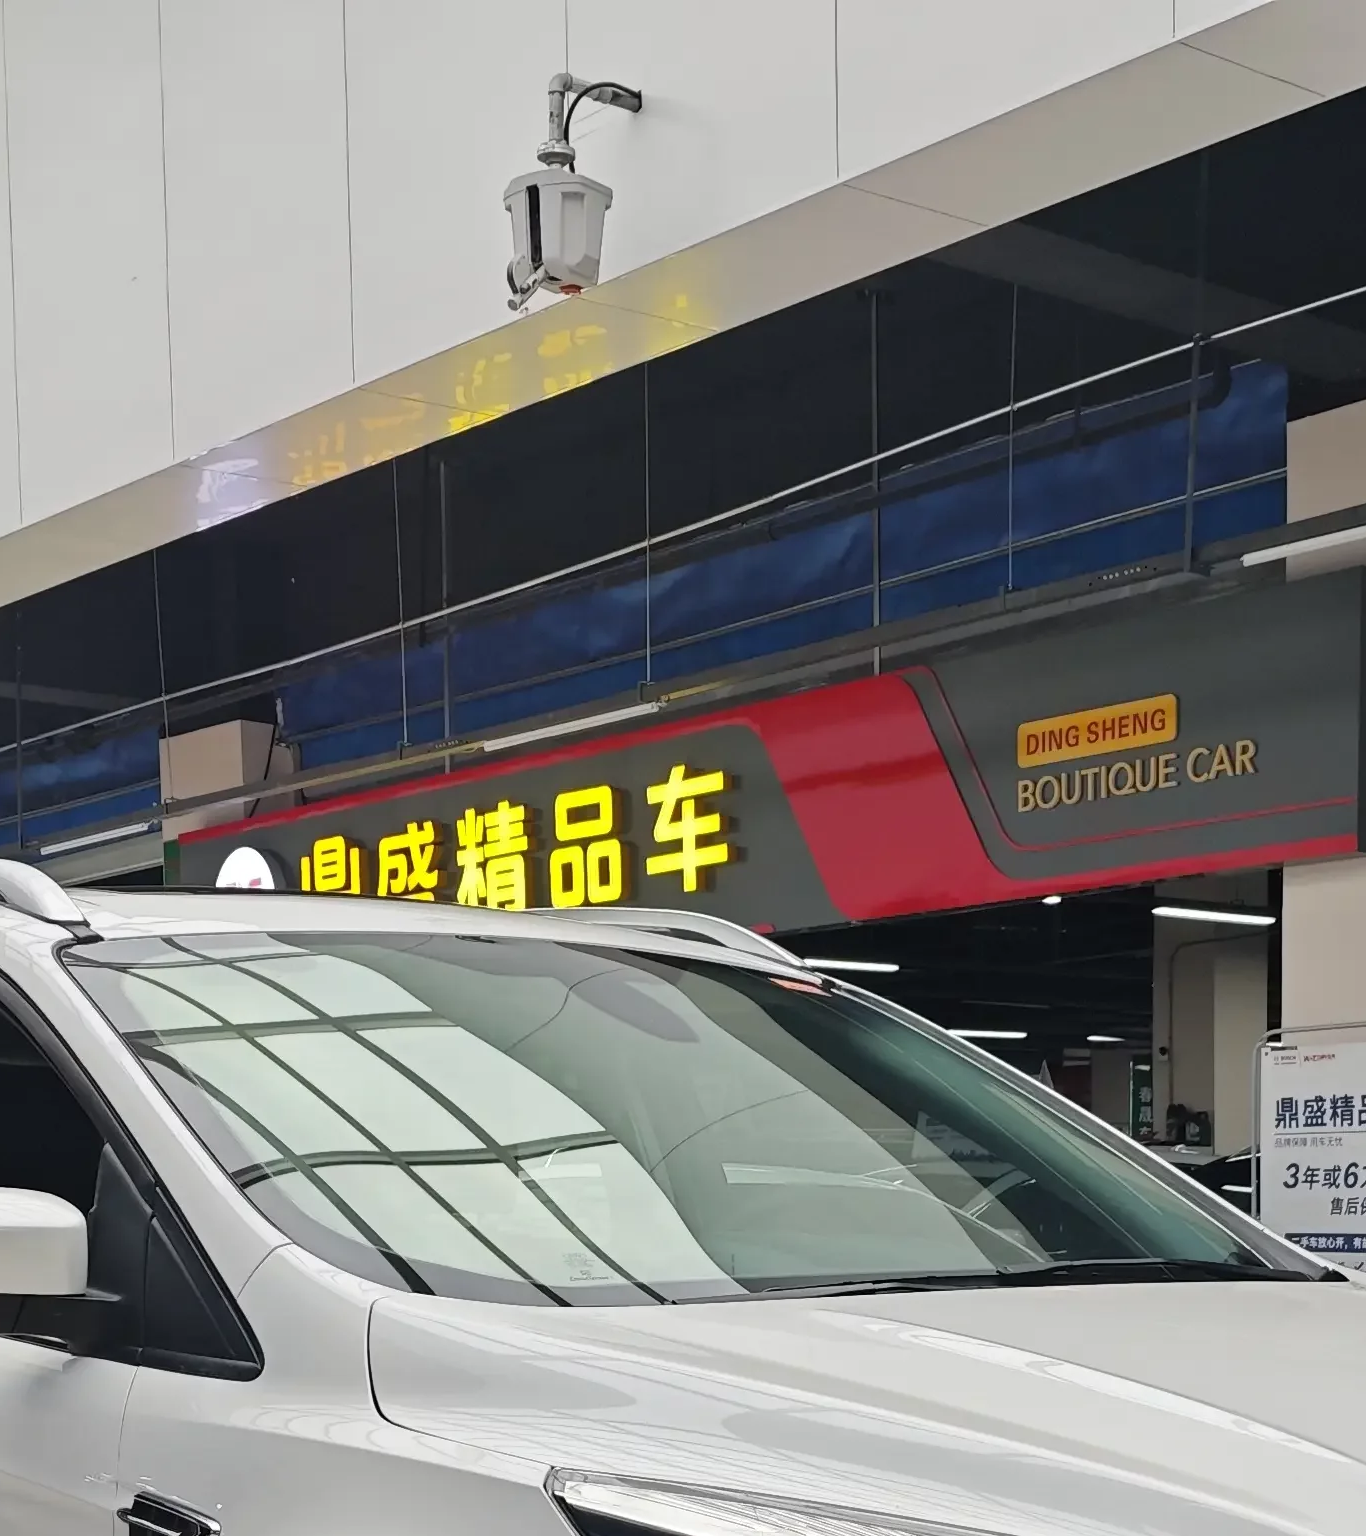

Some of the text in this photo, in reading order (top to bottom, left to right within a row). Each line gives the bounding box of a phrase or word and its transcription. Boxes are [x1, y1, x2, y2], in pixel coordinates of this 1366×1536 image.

[1026, 708, 1167, 756] DING SHENG
[1017, 739, 1258, 813] BOUTIQUE CAR
